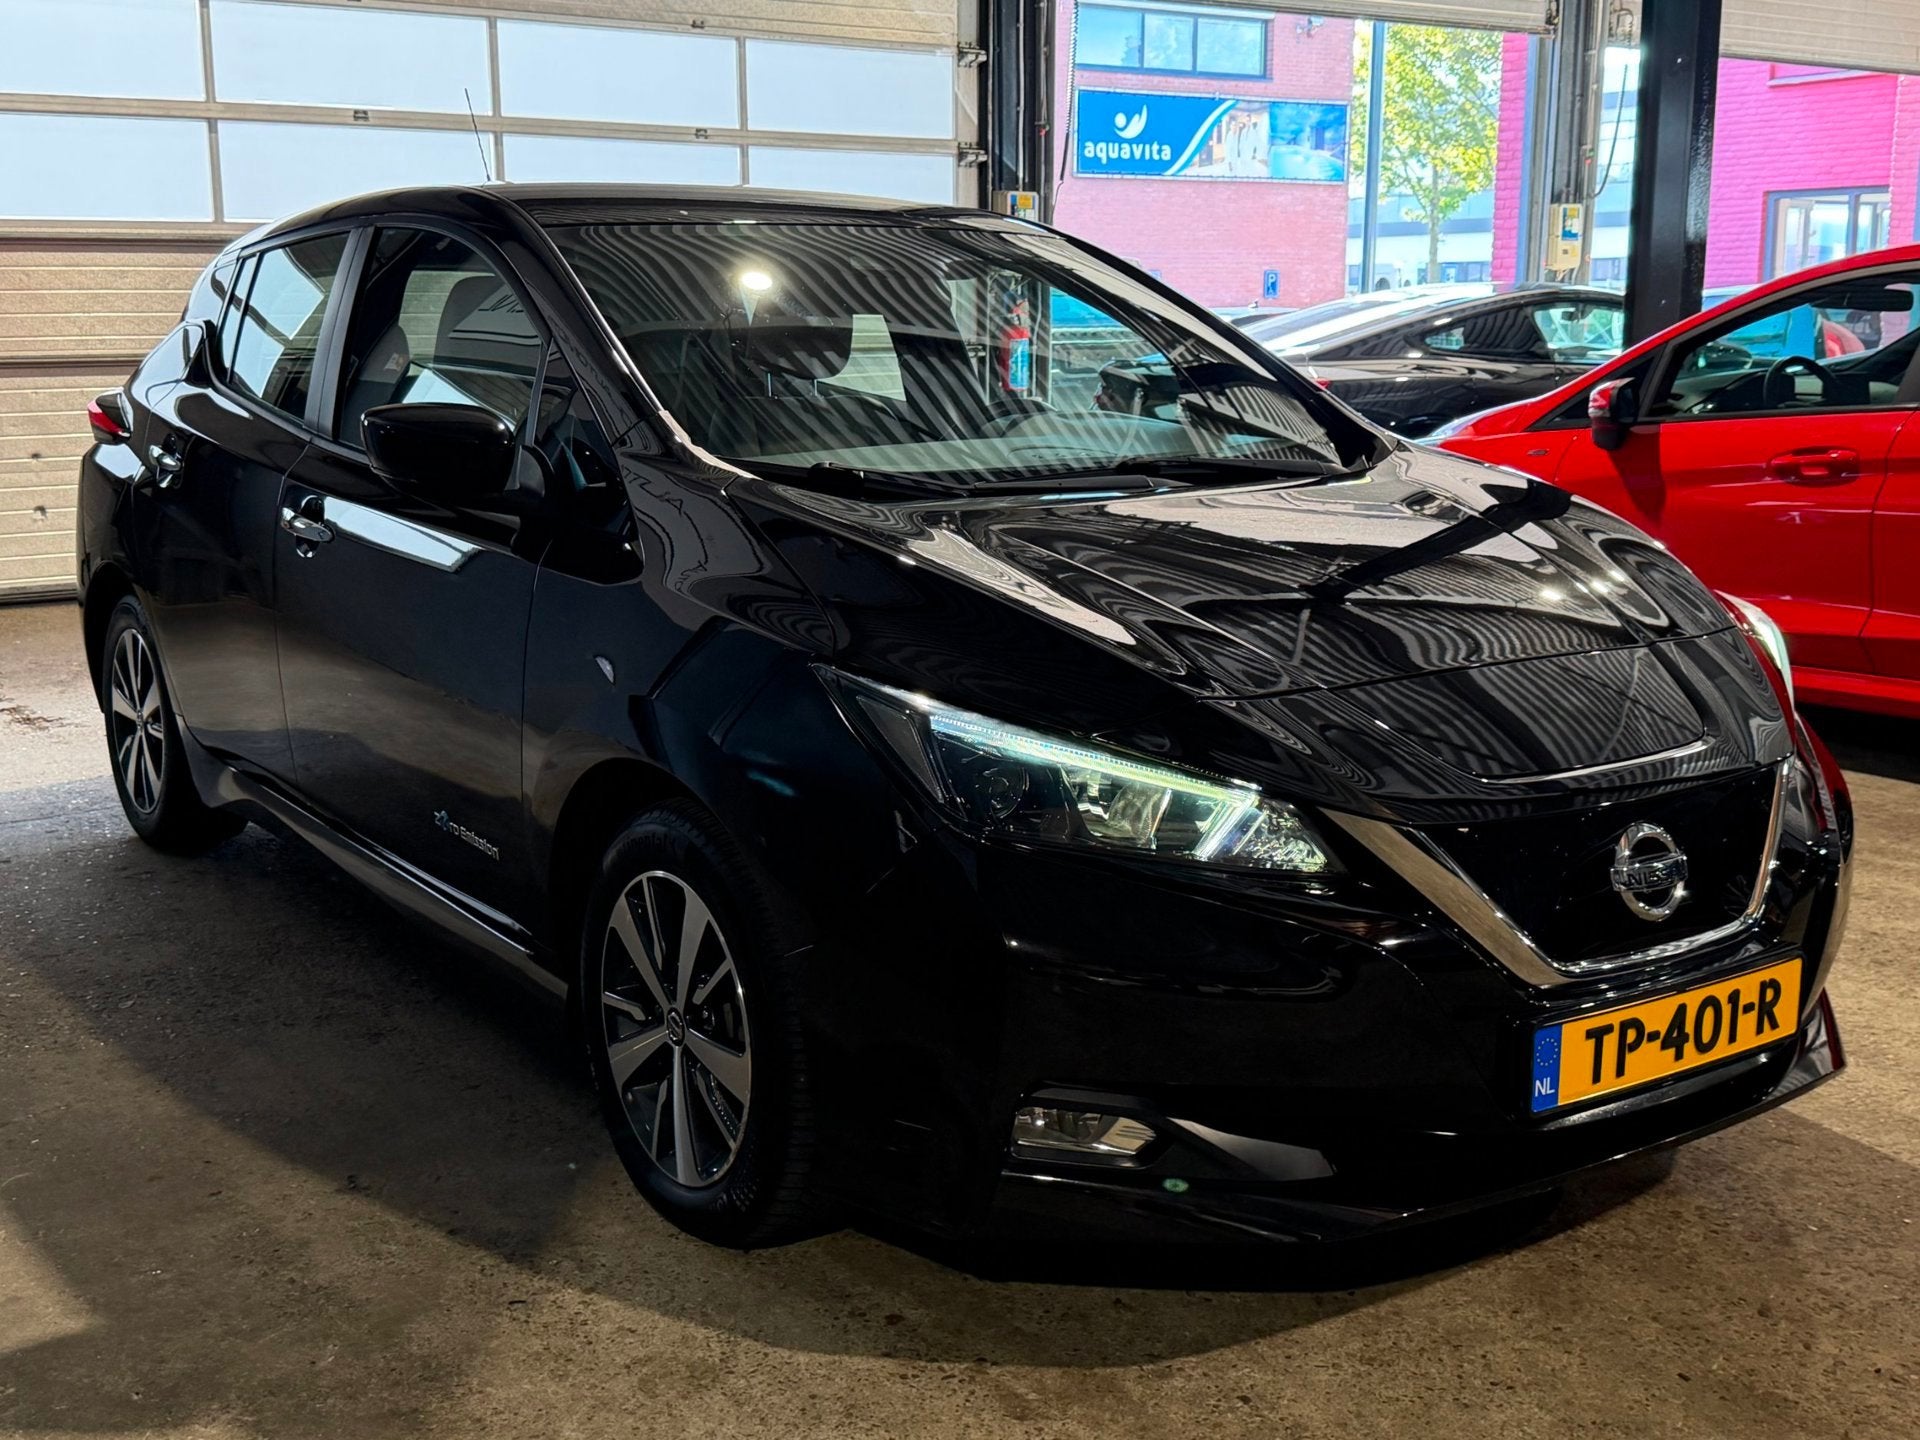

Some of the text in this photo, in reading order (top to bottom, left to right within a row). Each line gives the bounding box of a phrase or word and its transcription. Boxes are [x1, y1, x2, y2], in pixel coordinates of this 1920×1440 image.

[1083, 140, 1172, 165] aquavita
[1585, 978, 1782, 1085] TP-401-R
[1534, 1077, 1555, 1097] NL
